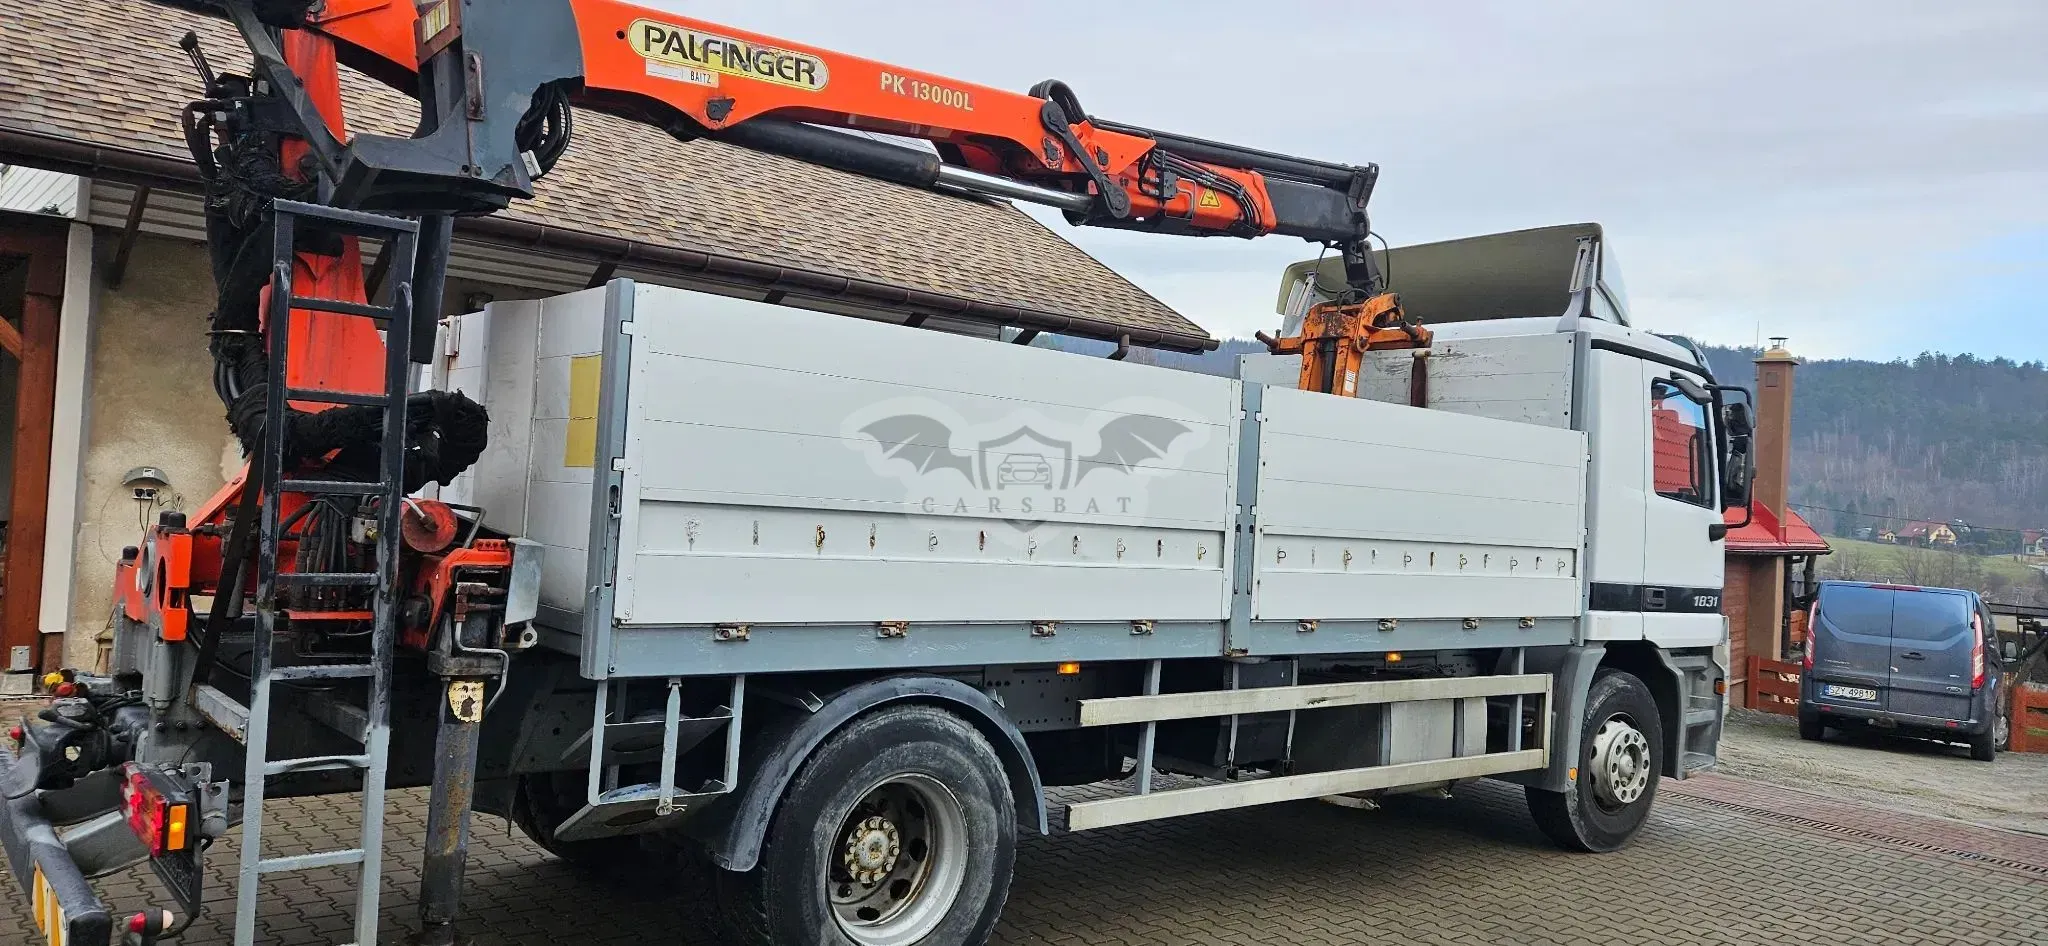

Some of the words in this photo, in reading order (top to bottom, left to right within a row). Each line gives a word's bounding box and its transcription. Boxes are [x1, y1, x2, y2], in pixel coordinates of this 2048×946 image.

[644, 24, 816, 85] PALFINGER
[881, 71, 906, 95] PK
[911, 80, 974, 111] 13000L
[1693, 595, 1719, 607] 1831
[1829, 685, 1846, 695] SZY
[1848, 688, 1875, 699] 49819
